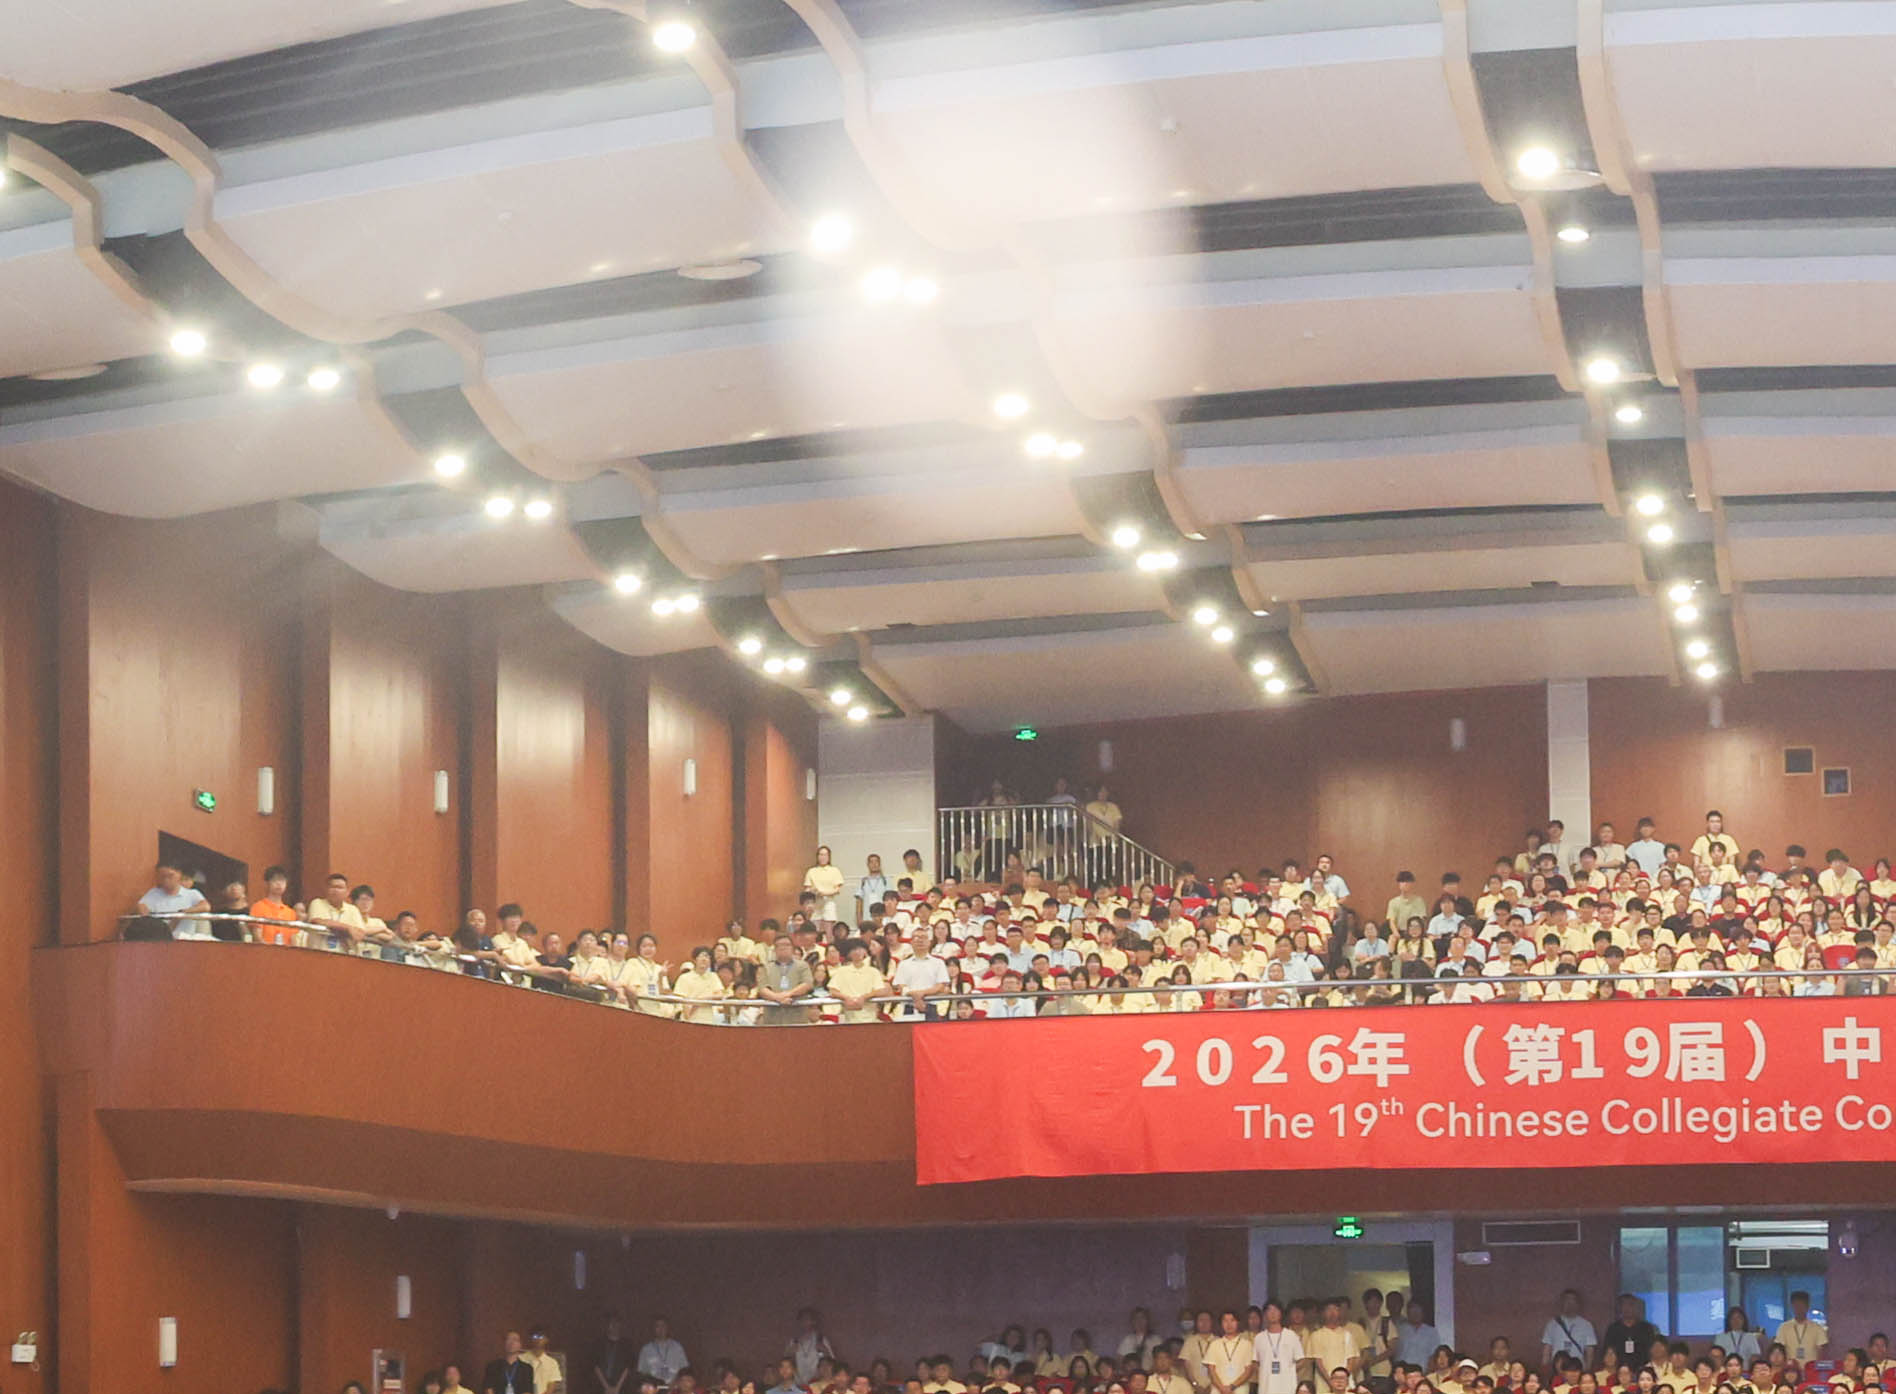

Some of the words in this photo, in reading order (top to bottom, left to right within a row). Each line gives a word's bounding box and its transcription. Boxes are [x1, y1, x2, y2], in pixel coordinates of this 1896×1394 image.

[1235, 1104, 1315, 1140] The
[1327, 1097, 1405, 1139] 19th
[1415, 1100, 1590, 1139] Chinese
[1600, 1096, 1823, 1144] Collegiate
